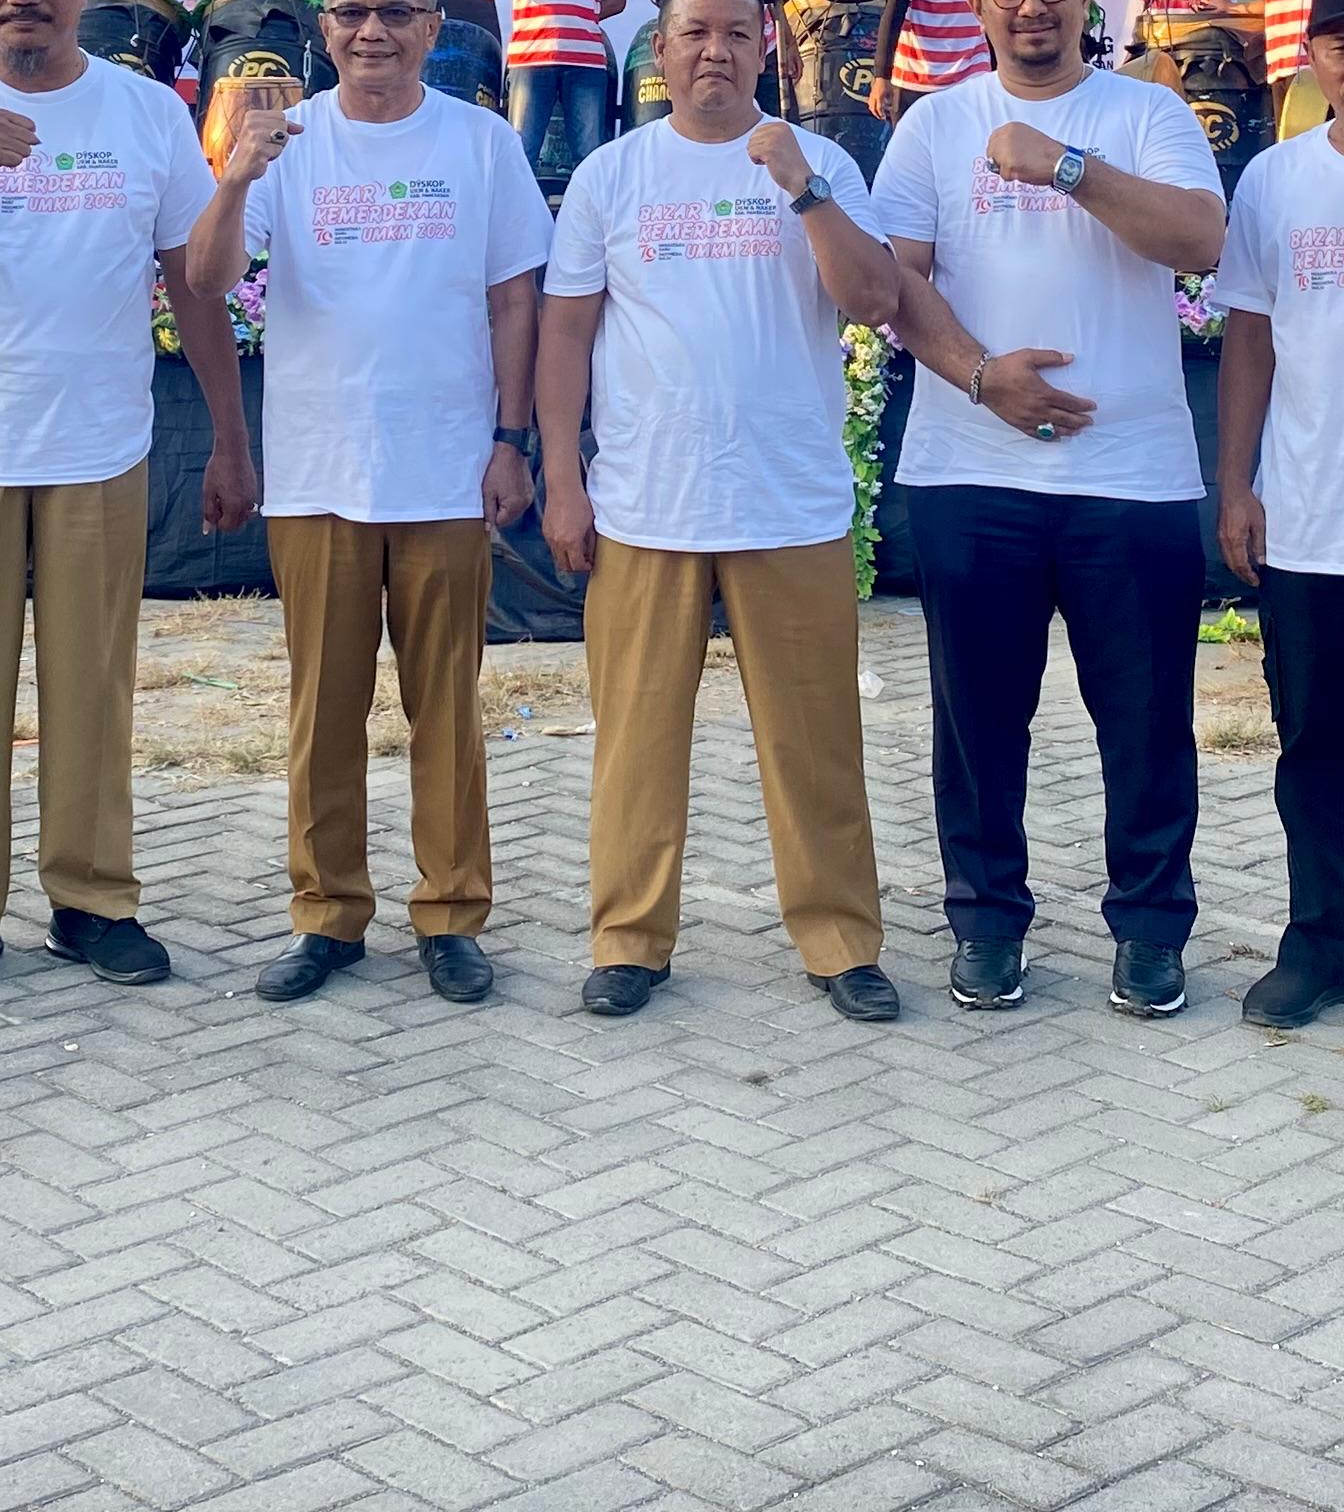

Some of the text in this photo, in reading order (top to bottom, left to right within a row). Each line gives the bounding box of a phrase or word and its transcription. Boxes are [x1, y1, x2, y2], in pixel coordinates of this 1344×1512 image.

[28, 196, 80, 213] UMKM
[84, 193, 127, 209] 2024
[312, 184, 376, 205] BAZAR
[312, 201, 456, 226] KEMERDEKAAN
[638, 202, 702, 223] BAZAR
[361, 225, 413, 243] UMKM
[416, 223, 456, 239] 2024
[639, 218, 782, 243] KEMERDEKAAN
[685, 242, 736, 260] UMKM
[739, 239, 782, 257] 2024
